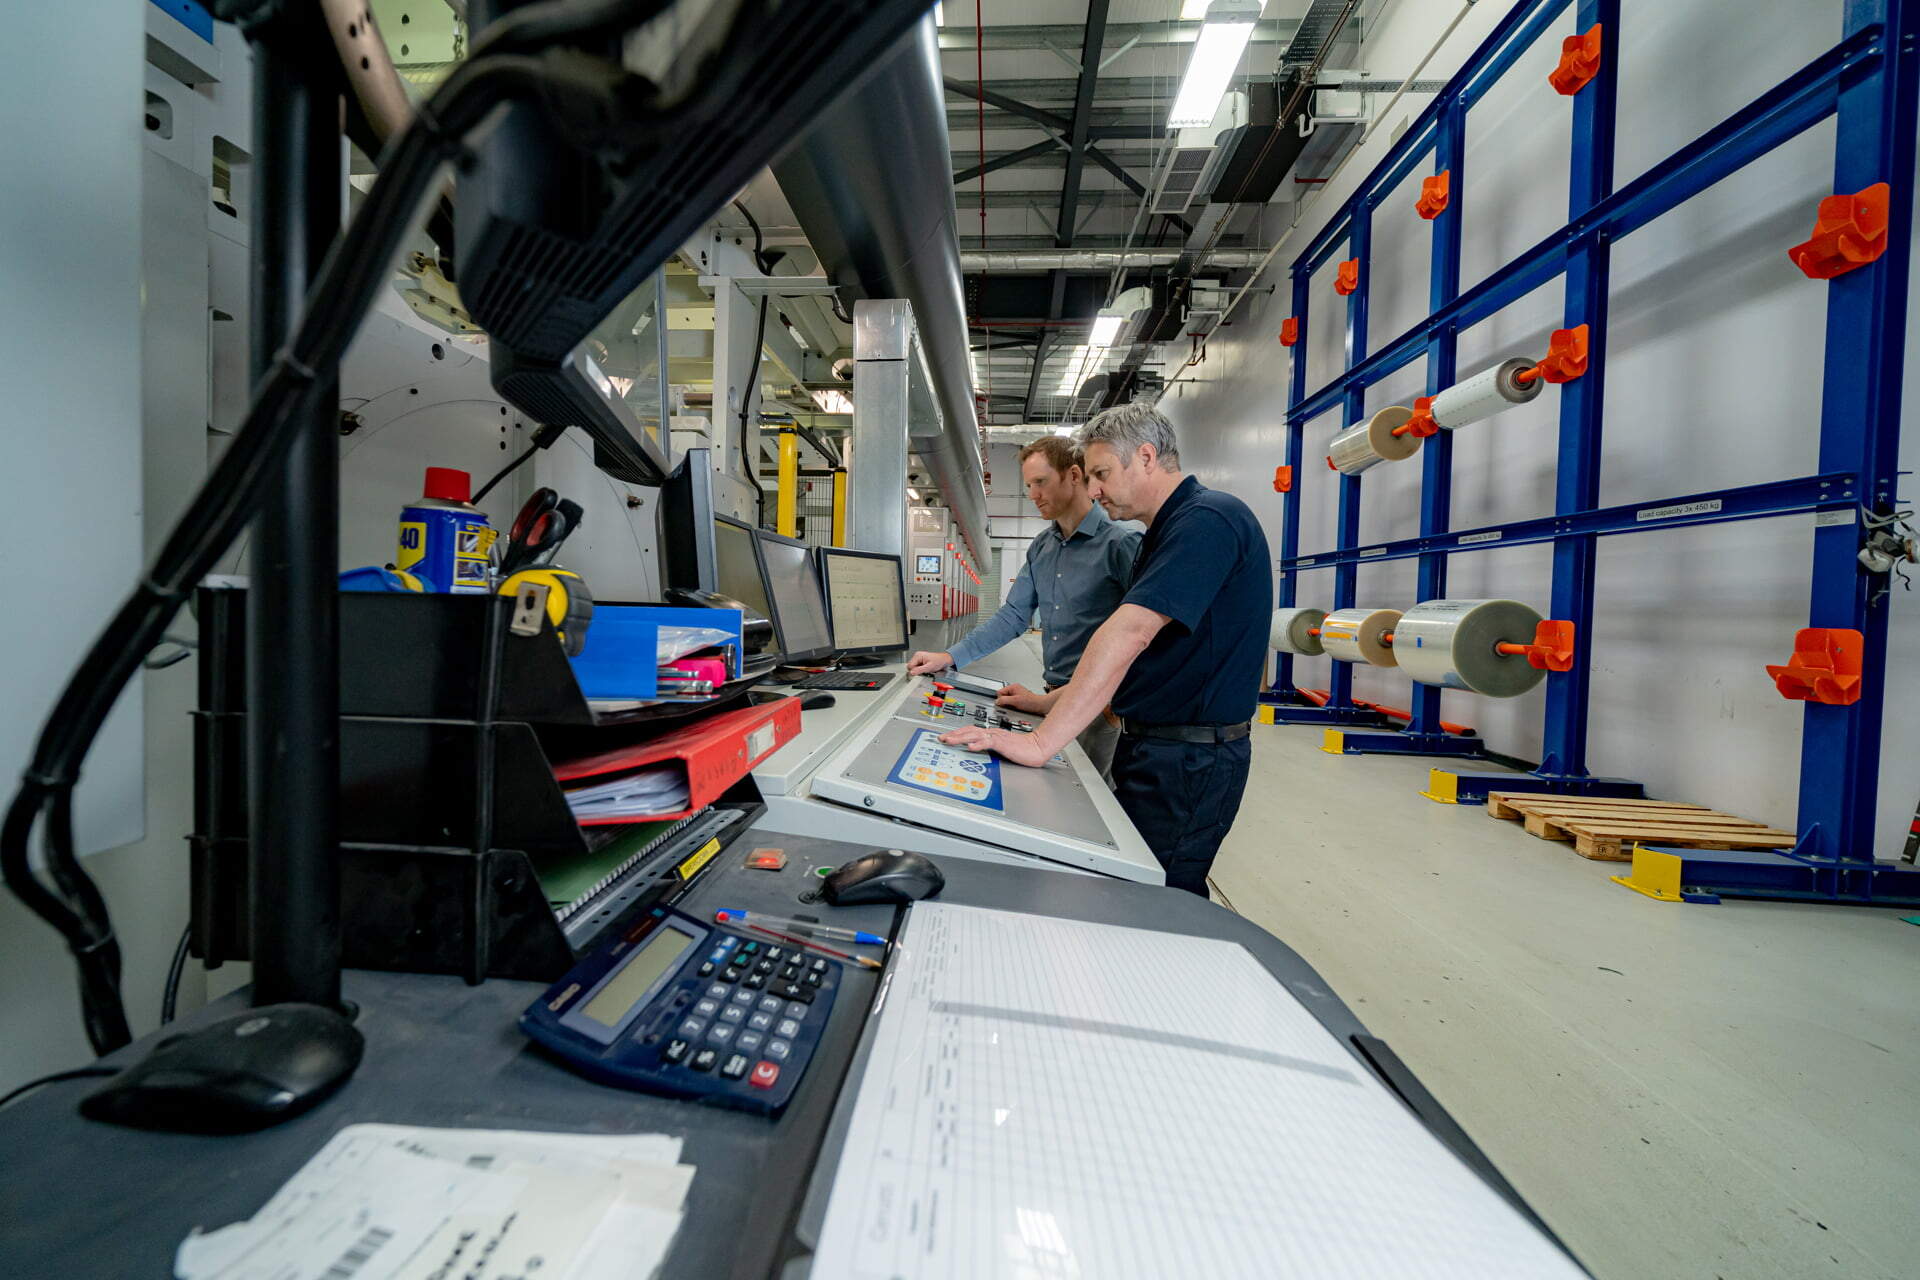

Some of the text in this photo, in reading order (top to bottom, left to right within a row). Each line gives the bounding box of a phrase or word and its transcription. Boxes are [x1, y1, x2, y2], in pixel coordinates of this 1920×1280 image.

[1656, 507, 1682, 517] capacity
[1695, 503, 1708, 512] 450
[1710, 502, 1720, 510] kg
[685, 1020, 700, 1031] 7
[700, 1002, 714, 1012] 8
[712, 985, 726, 995] 9
[714, 1028, 729, 1038] 4
[726, 1007, 741, 1017] 5
[737, 991, 751, 1001] 6
[743, 998, 777, 1044] 1 2 3
[756, 1064, 774, 1079] C
